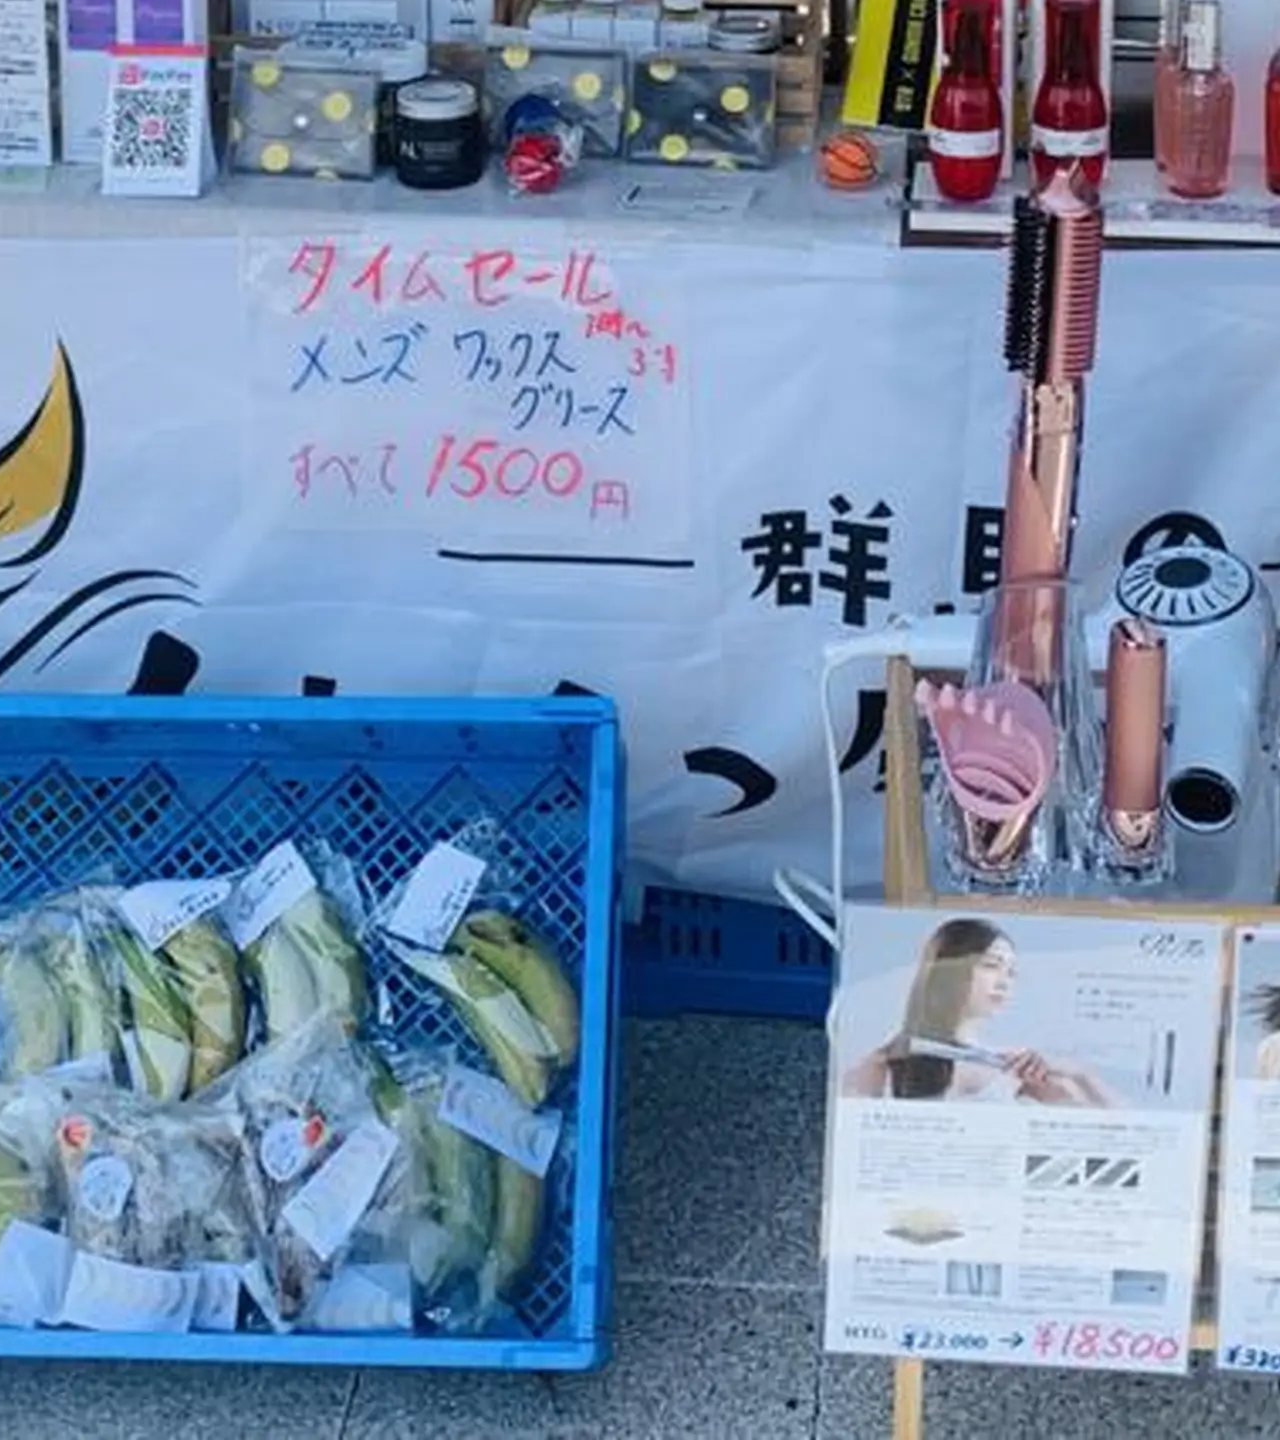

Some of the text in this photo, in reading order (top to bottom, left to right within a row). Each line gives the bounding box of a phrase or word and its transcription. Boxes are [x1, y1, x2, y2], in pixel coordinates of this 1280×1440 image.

[286, 243, 613, 316] タイムセール
[290, 320, 578, 393] メンズ ワックス
[509, 384, 636, 435] グリース
